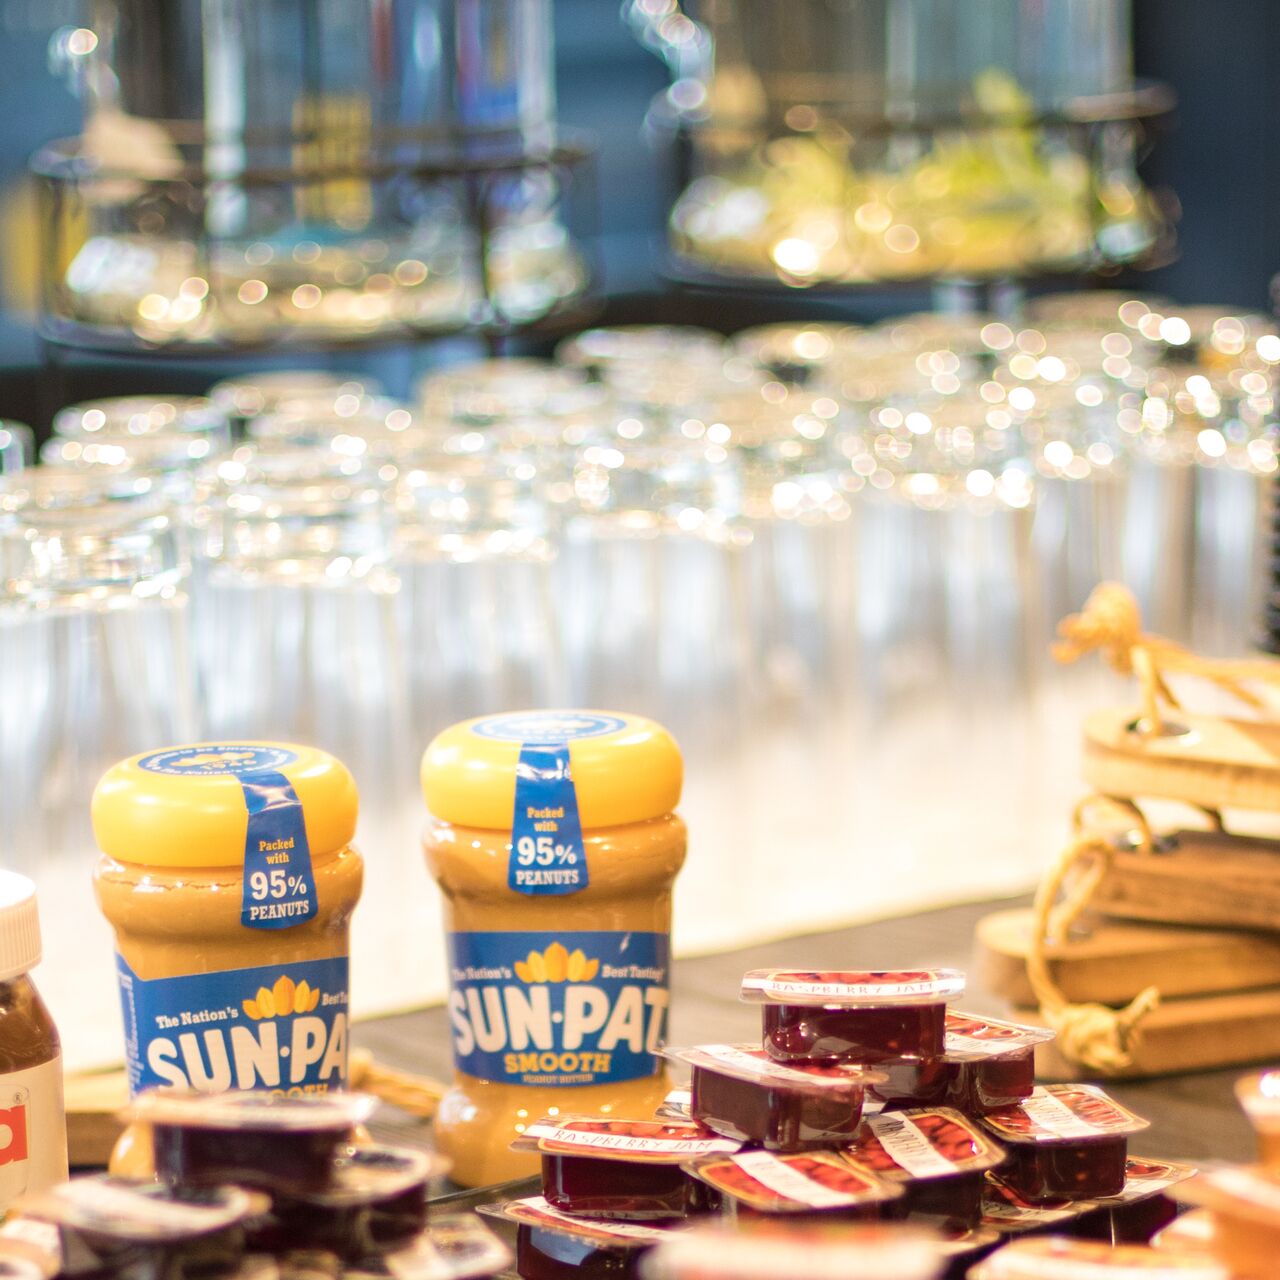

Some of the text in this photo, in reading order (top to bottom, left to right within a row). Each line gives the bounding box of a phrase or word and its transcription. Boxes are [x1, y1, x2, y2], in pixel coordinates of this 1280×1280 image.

[527, 805, 564, 819] Packed
[533, 820, 558, 832] with
[259, 837, 294, 852] Packed
[517, 836, 577, 866] 95%
[266, 852, 289, 864] with
[250, 869, 307, 900] 95%
[516, 869, 579, 885] PEANUTS
[250, 900, 309, 920] PEANUTS
[602, 965, 628, 978] Best
[155, 1006, 239, 1029] The Nation's
[503, 1051, 612, 1073] SMOOTH
